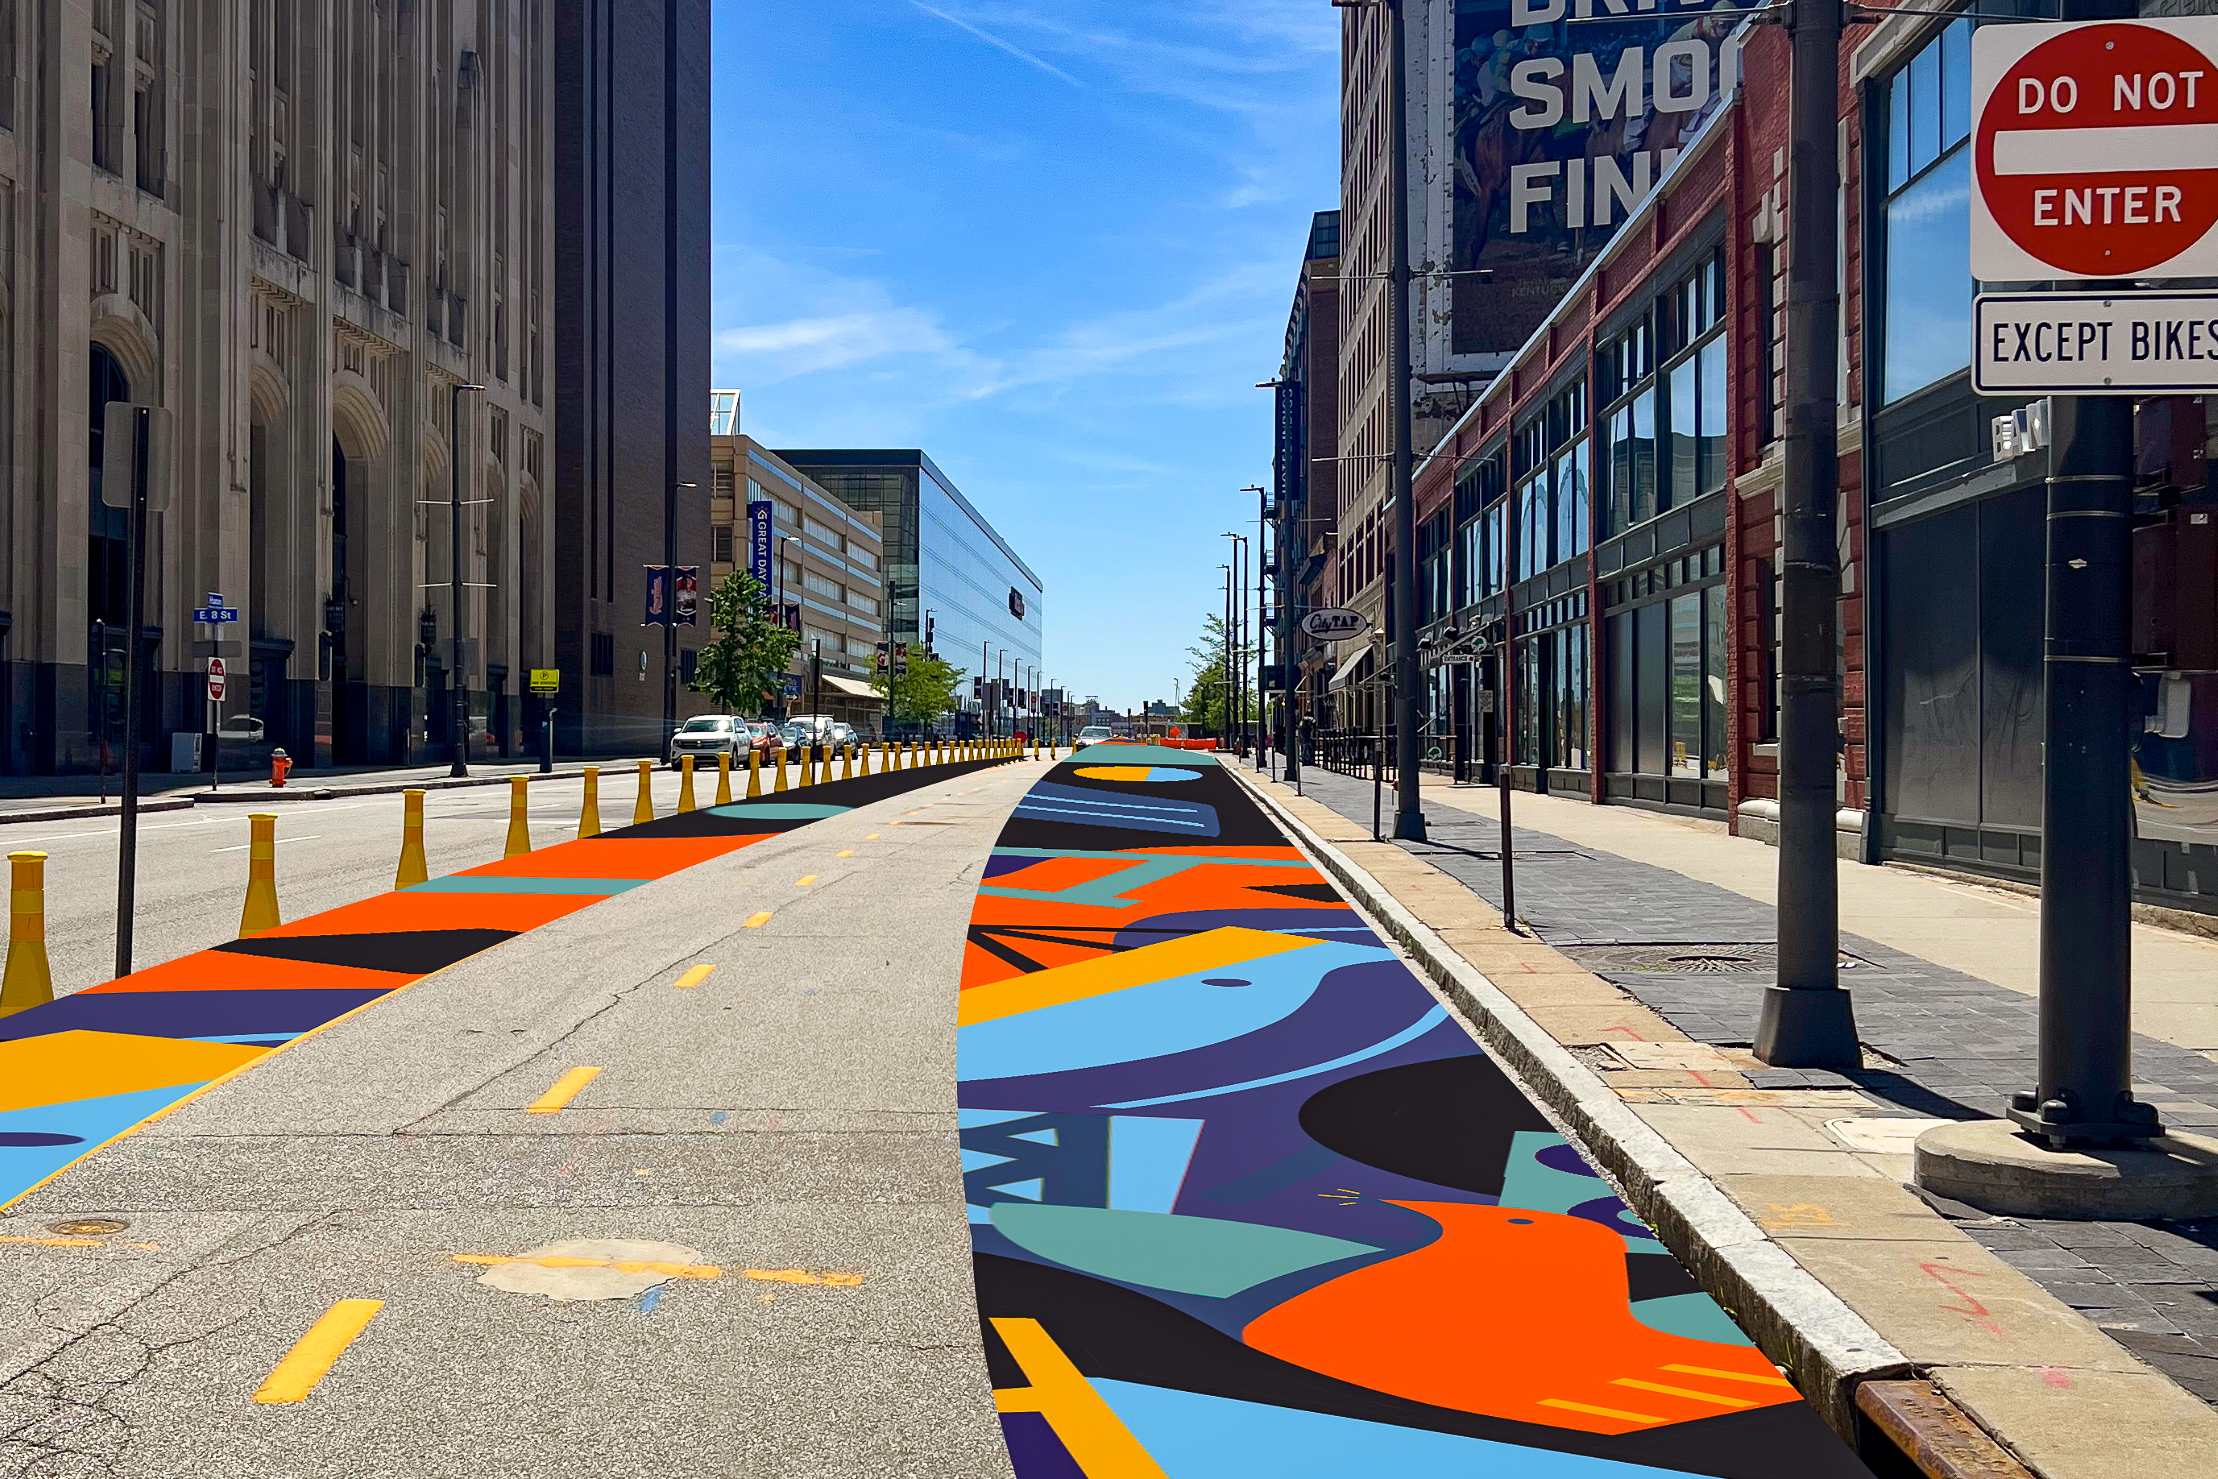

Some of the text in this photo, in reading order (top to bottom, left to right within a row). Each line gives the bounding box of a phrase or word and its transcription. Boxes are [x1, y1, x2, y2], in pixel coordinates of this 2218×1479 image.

[2018, 71, 2204, 115] DO NOT
[2034, 186, 2182, 226] ENTER
[1511, 283, 1570, 298] KENTUCK
[1993, 319, 2218, 363] EXCEPT BIKES
[1991, 396, 2052, 462] BAN
[757, 521, 767, 557] GREAT
[757, 559, 767, 580] DAY
[211, 610, 218, 620] 8
